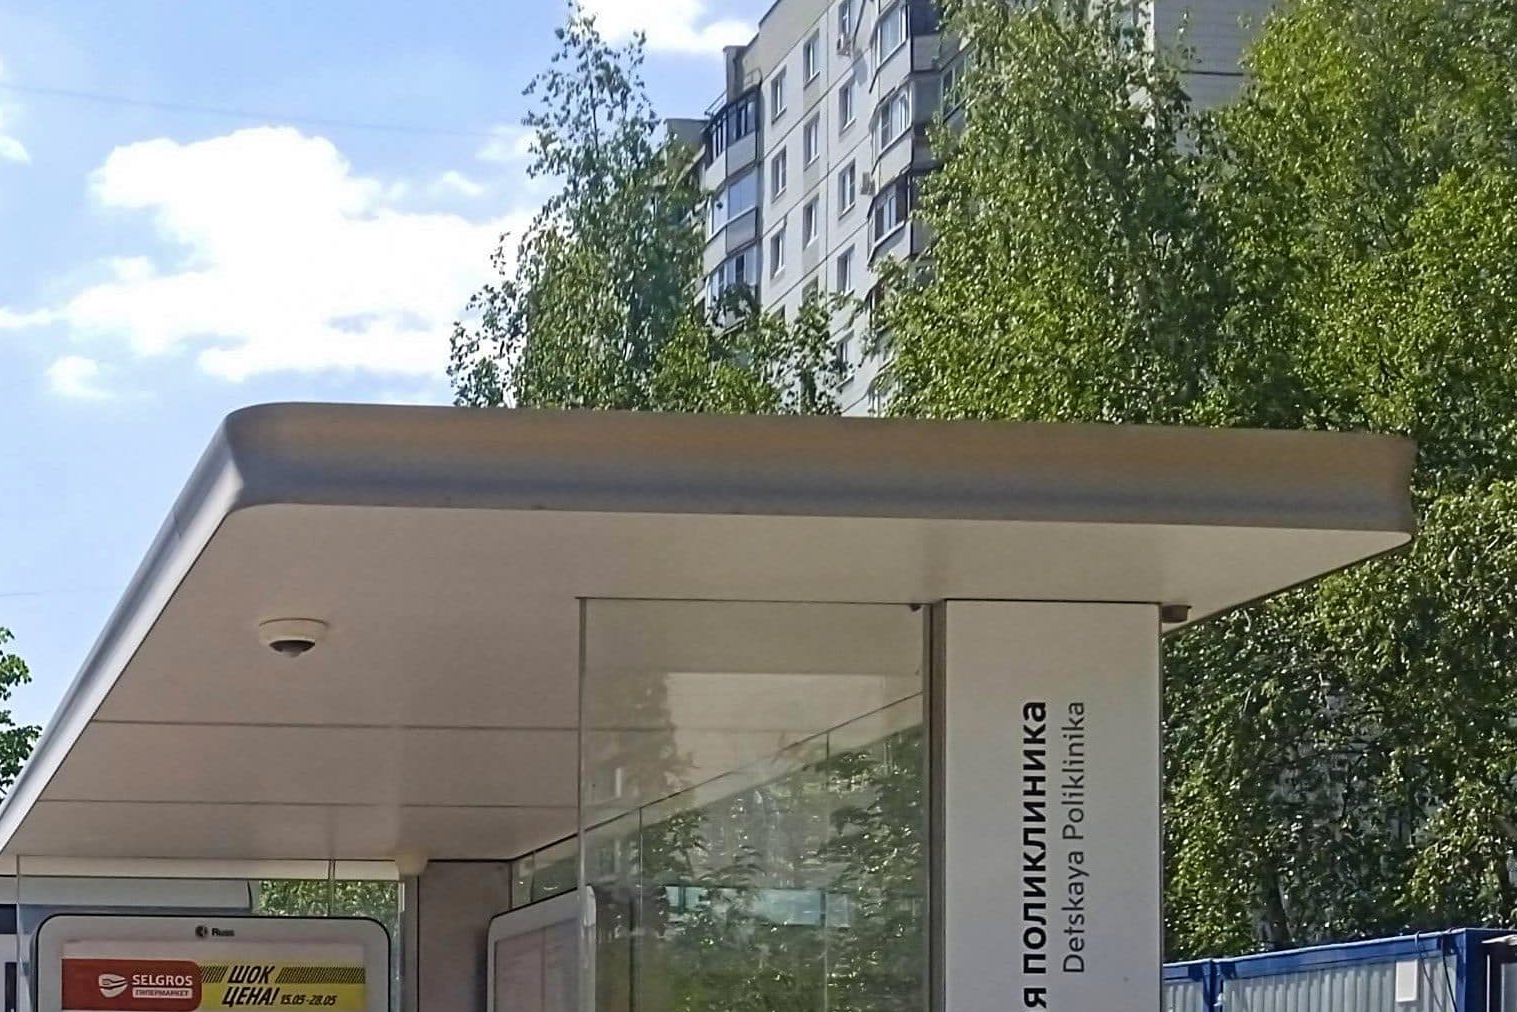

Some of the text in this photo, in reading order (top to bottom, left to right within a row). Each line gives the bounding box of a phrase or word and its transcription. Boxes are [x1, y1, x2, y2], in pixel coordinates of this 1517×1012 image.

[1023, 701, 1046, 974] поликлиника
[1062, 702, 1090, 973] Detskaya Poliklinika
[132, 974, 194, 987] SELGROS
[227, 965, 276, 985] ШОК
[222, 986, 281, 1008] ЦЕНА!
